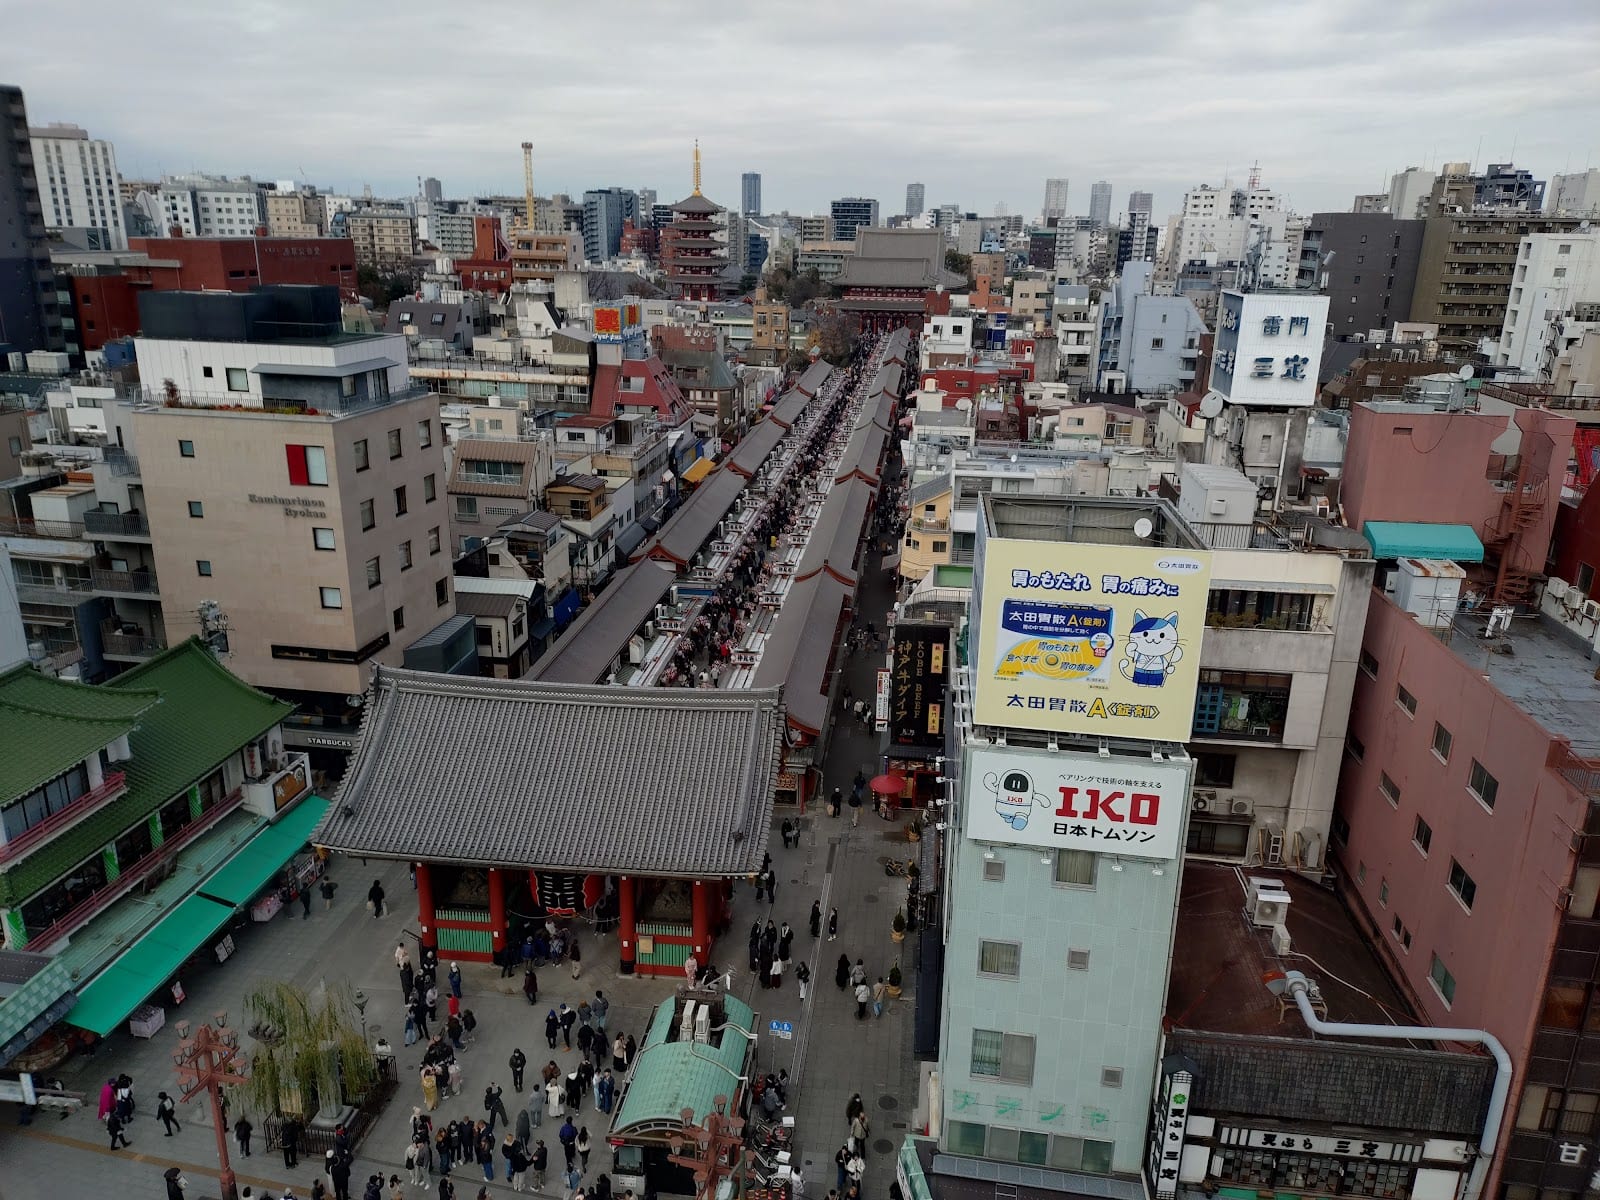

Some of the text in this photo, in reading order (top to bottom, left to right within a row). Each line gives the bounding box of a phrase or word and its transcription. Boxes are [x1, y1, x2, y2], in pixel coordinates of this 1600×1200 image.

[1262, 315, 1310, 337] 雷門
[1249, 353, 1310, 382] 三定
[247, 493, 326, 508] Kaminarimon
[284, 507, 327, 519] Ryokan
[1011, 569, 1180, 597] 胃のもたれ 胃の痛みに
[1037, 640, 1079, 653] 胃のもたれ
[1006, 654, 1040, 664] 食べすぎ
[1059, 661, 1097, 673] 胃の痛み
[895, 639, 913, 722] 神戸牛ダイア
[913, 640, 925, 719] KOBE BEEF
[307, 737, 352, 747] STARBUCKS
[1058, 773, 1163, 790] ベアリングで技術の軸を支える
[1007, 795, 1023, 804] IKO
[1055, 786, 1161, 826] IKO
[1052, 822, 1157, 844] 日本トムソン
[1169, 1108, 1185, 1142] 天ぷら
[1261, 1133, 1379, 1158] 天ぷら 三定
[1159, 1150, 1179, 1180] 三定
